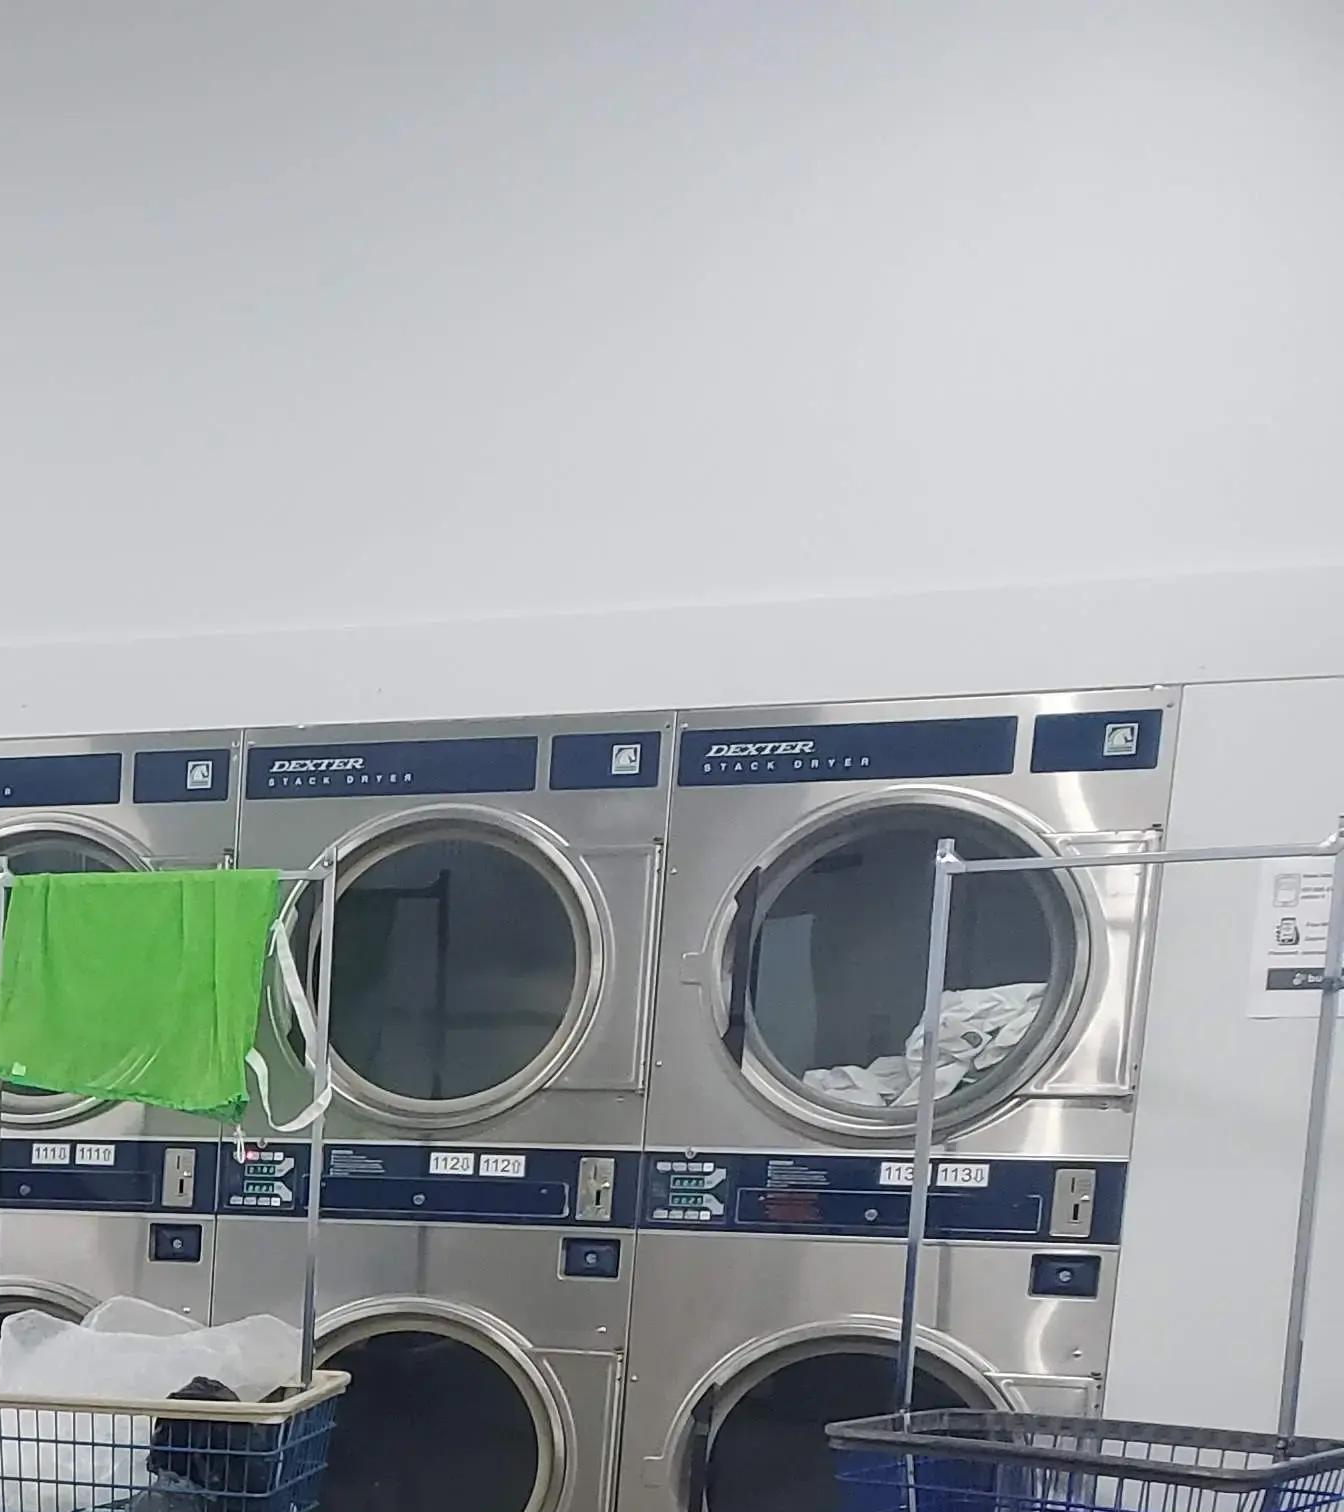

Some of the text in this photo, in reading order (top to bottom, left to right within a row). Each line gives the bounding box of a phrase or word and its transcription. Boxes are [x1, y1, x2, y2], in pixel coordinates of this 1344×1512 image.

[704, 741, 815, 757] DEXTER
[269, 758, 365, 772] DEXTER
[703, 757, 870, 773] STACK DRYER
[268, 773, 412, 787] STACK DRYER
[433, 1156, 460, 1171] 112
[483, 1158, 511, 1173] 112
[941, 1167, 972, 1183] 113
